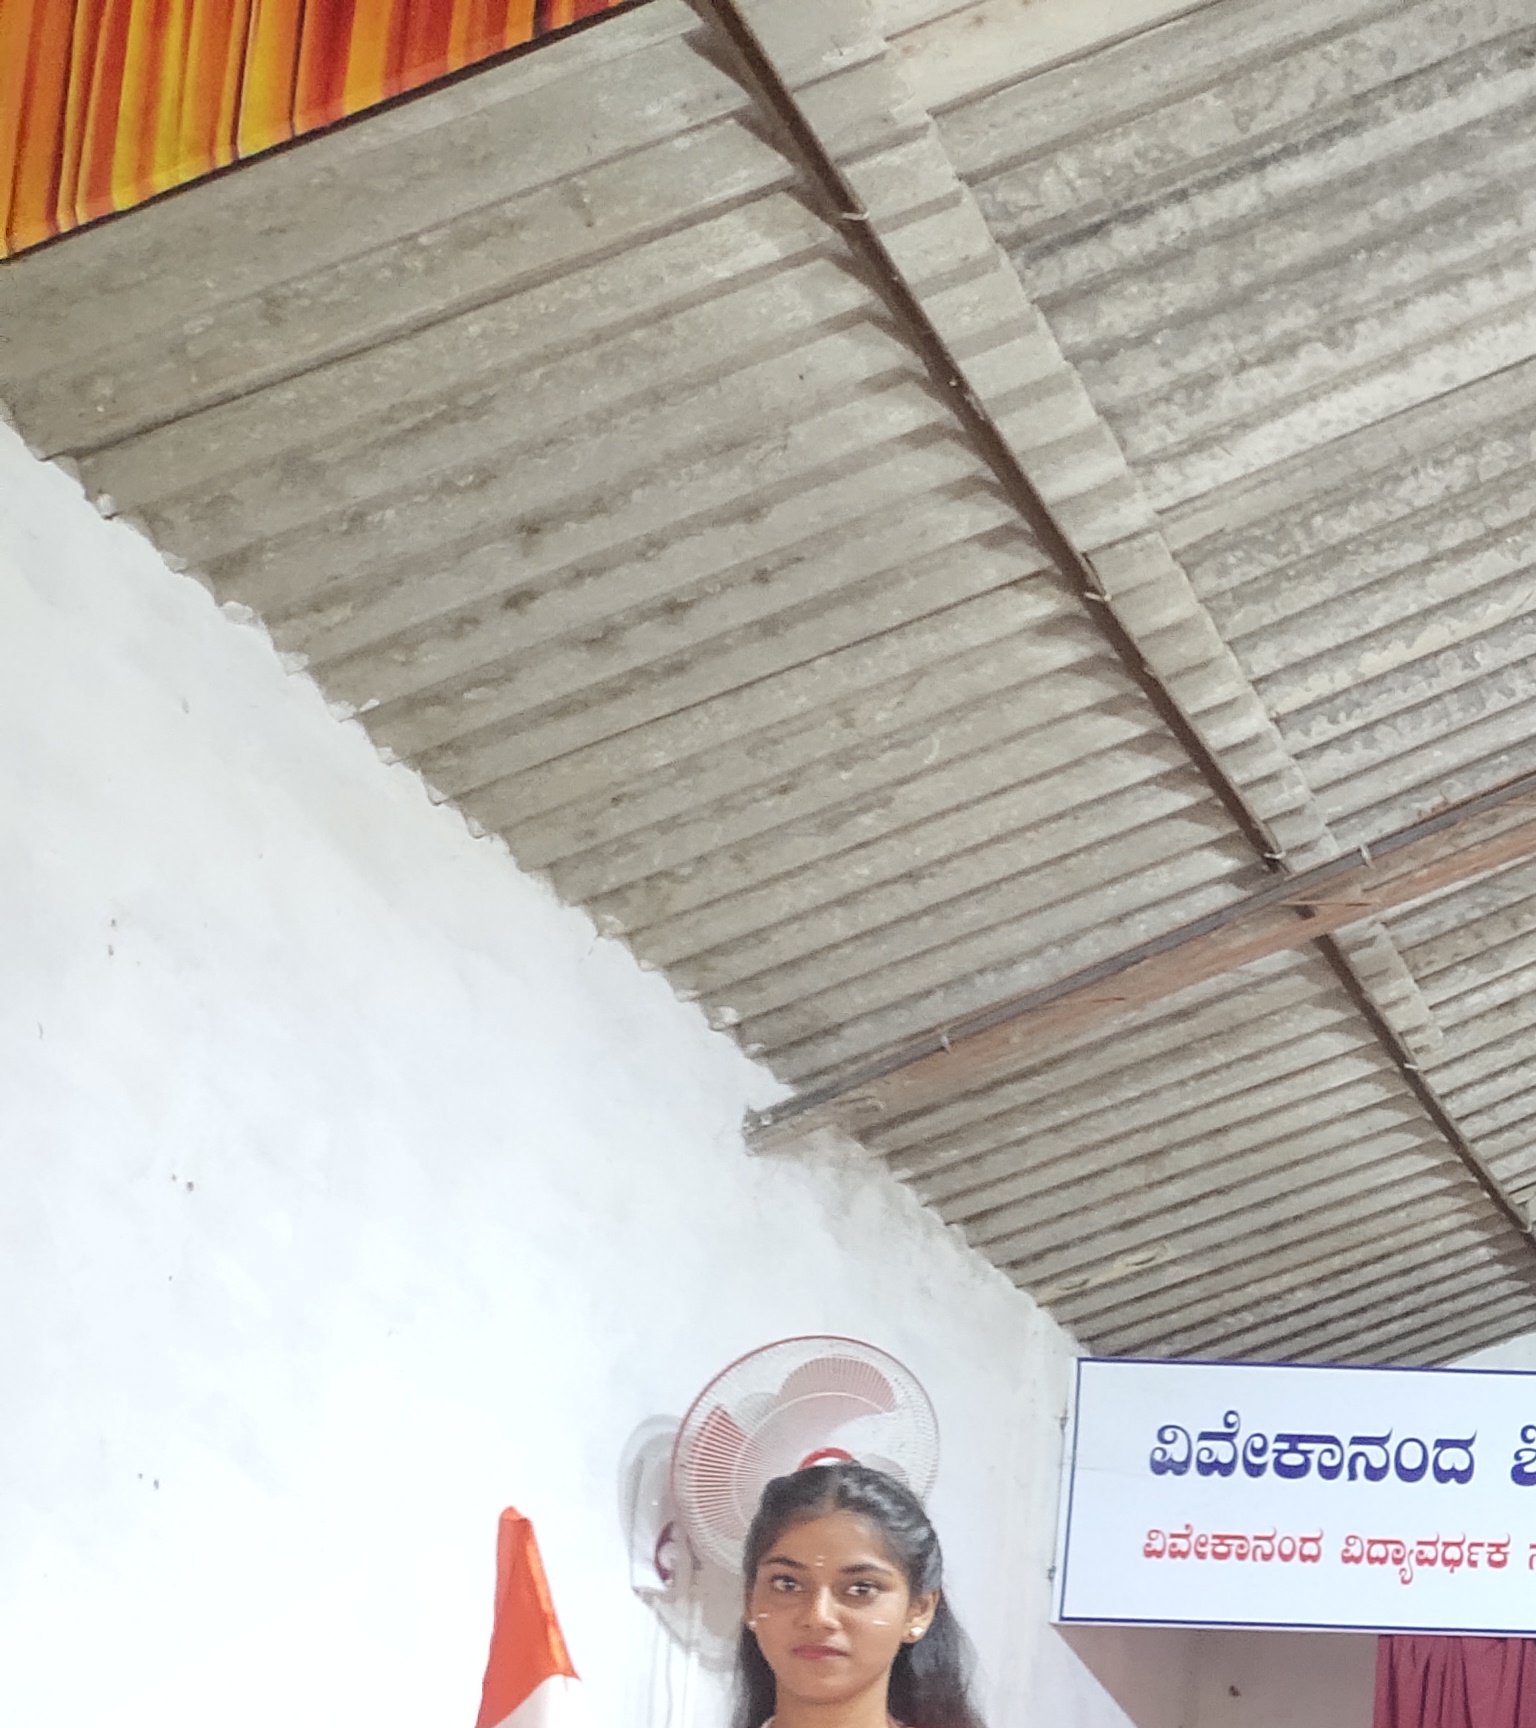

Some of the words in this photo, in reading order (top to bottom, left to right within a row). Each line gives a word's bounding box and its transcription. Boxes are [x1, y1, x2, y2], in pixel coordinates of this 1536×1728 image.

[1149, 1409, 1478, 1485] ವಿವೇಕಾನಂದ
[1142, 1523, 1324, 1564] ವಿವೇಕಾನಂದ
[1340, 1532, 1511, 1586] ವಿದ್ಯಾವರ್ಧಕ
